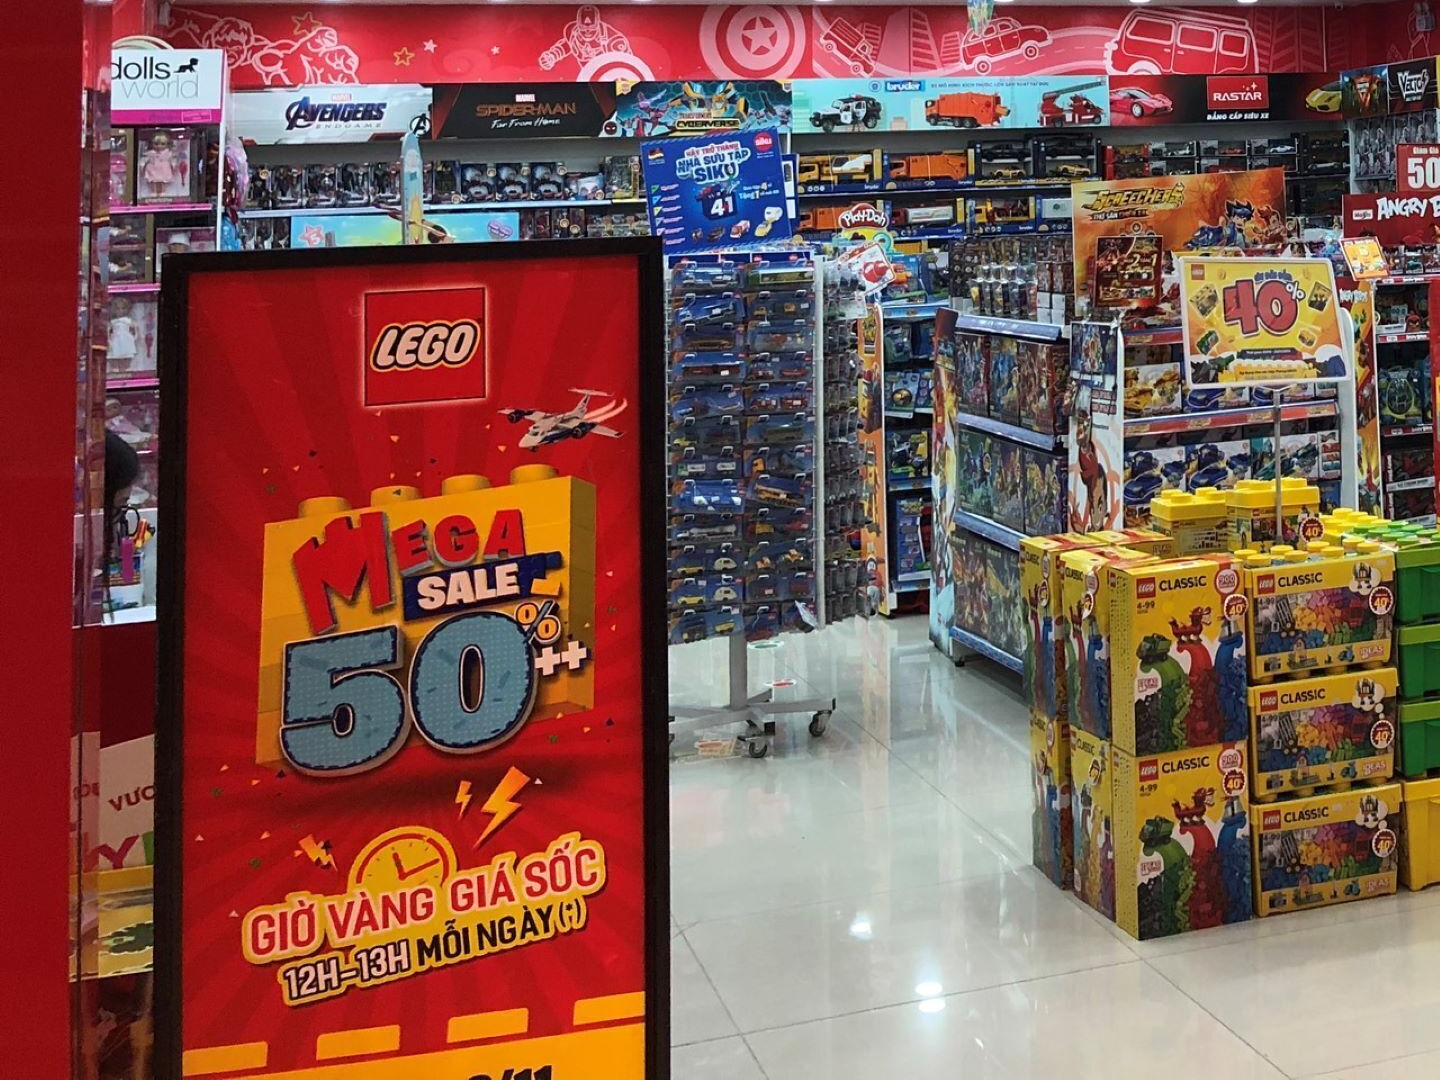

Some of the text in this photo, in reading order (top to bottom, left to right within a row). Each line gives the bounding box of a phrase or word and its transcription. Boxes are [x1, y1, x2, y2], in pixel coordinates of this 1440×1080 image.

[111, 56, 171, 81] dolls
[121, 74, 199, 100] world
[885, 80, 922, 92] bruder
[1213, 90, 1263, 102] RASTAR
[285, 95, 388, 131] AVENGERS
[474, 101, 577, 118] SPIDER-MAN
[693, 163, 738, 183] SIKU
[843, 209, 888, 229] Play-Doh
[1376, 196, 1427, 221] ANGRY
[1222, 279, 1306, 339] 40%
[371, 321, 480, 370] LEGO
[292, 508, 527, 633] MEGA
[1277, 572, 1323, 588] CLASSIC
[417, 563, 521, 610] SALE
[1137, 582, 1155, 594] LEGO
[1158, 576, 1207, 592] CLASSIC
[1261, 688, 1326, 706] LEGO CLASSIC
[1161, 756, 1210, 774] CLASSIC
[1283, 806, 1329, 824] CLASSIC
[250, 836, 599, 956] GIỜ VÀNG GIÁ SỐC
[284, 938, 412, 1001] 12H-13H
[417, 919, 471, 967] MỖI
[477, 902, 554, 951] NGÀY
